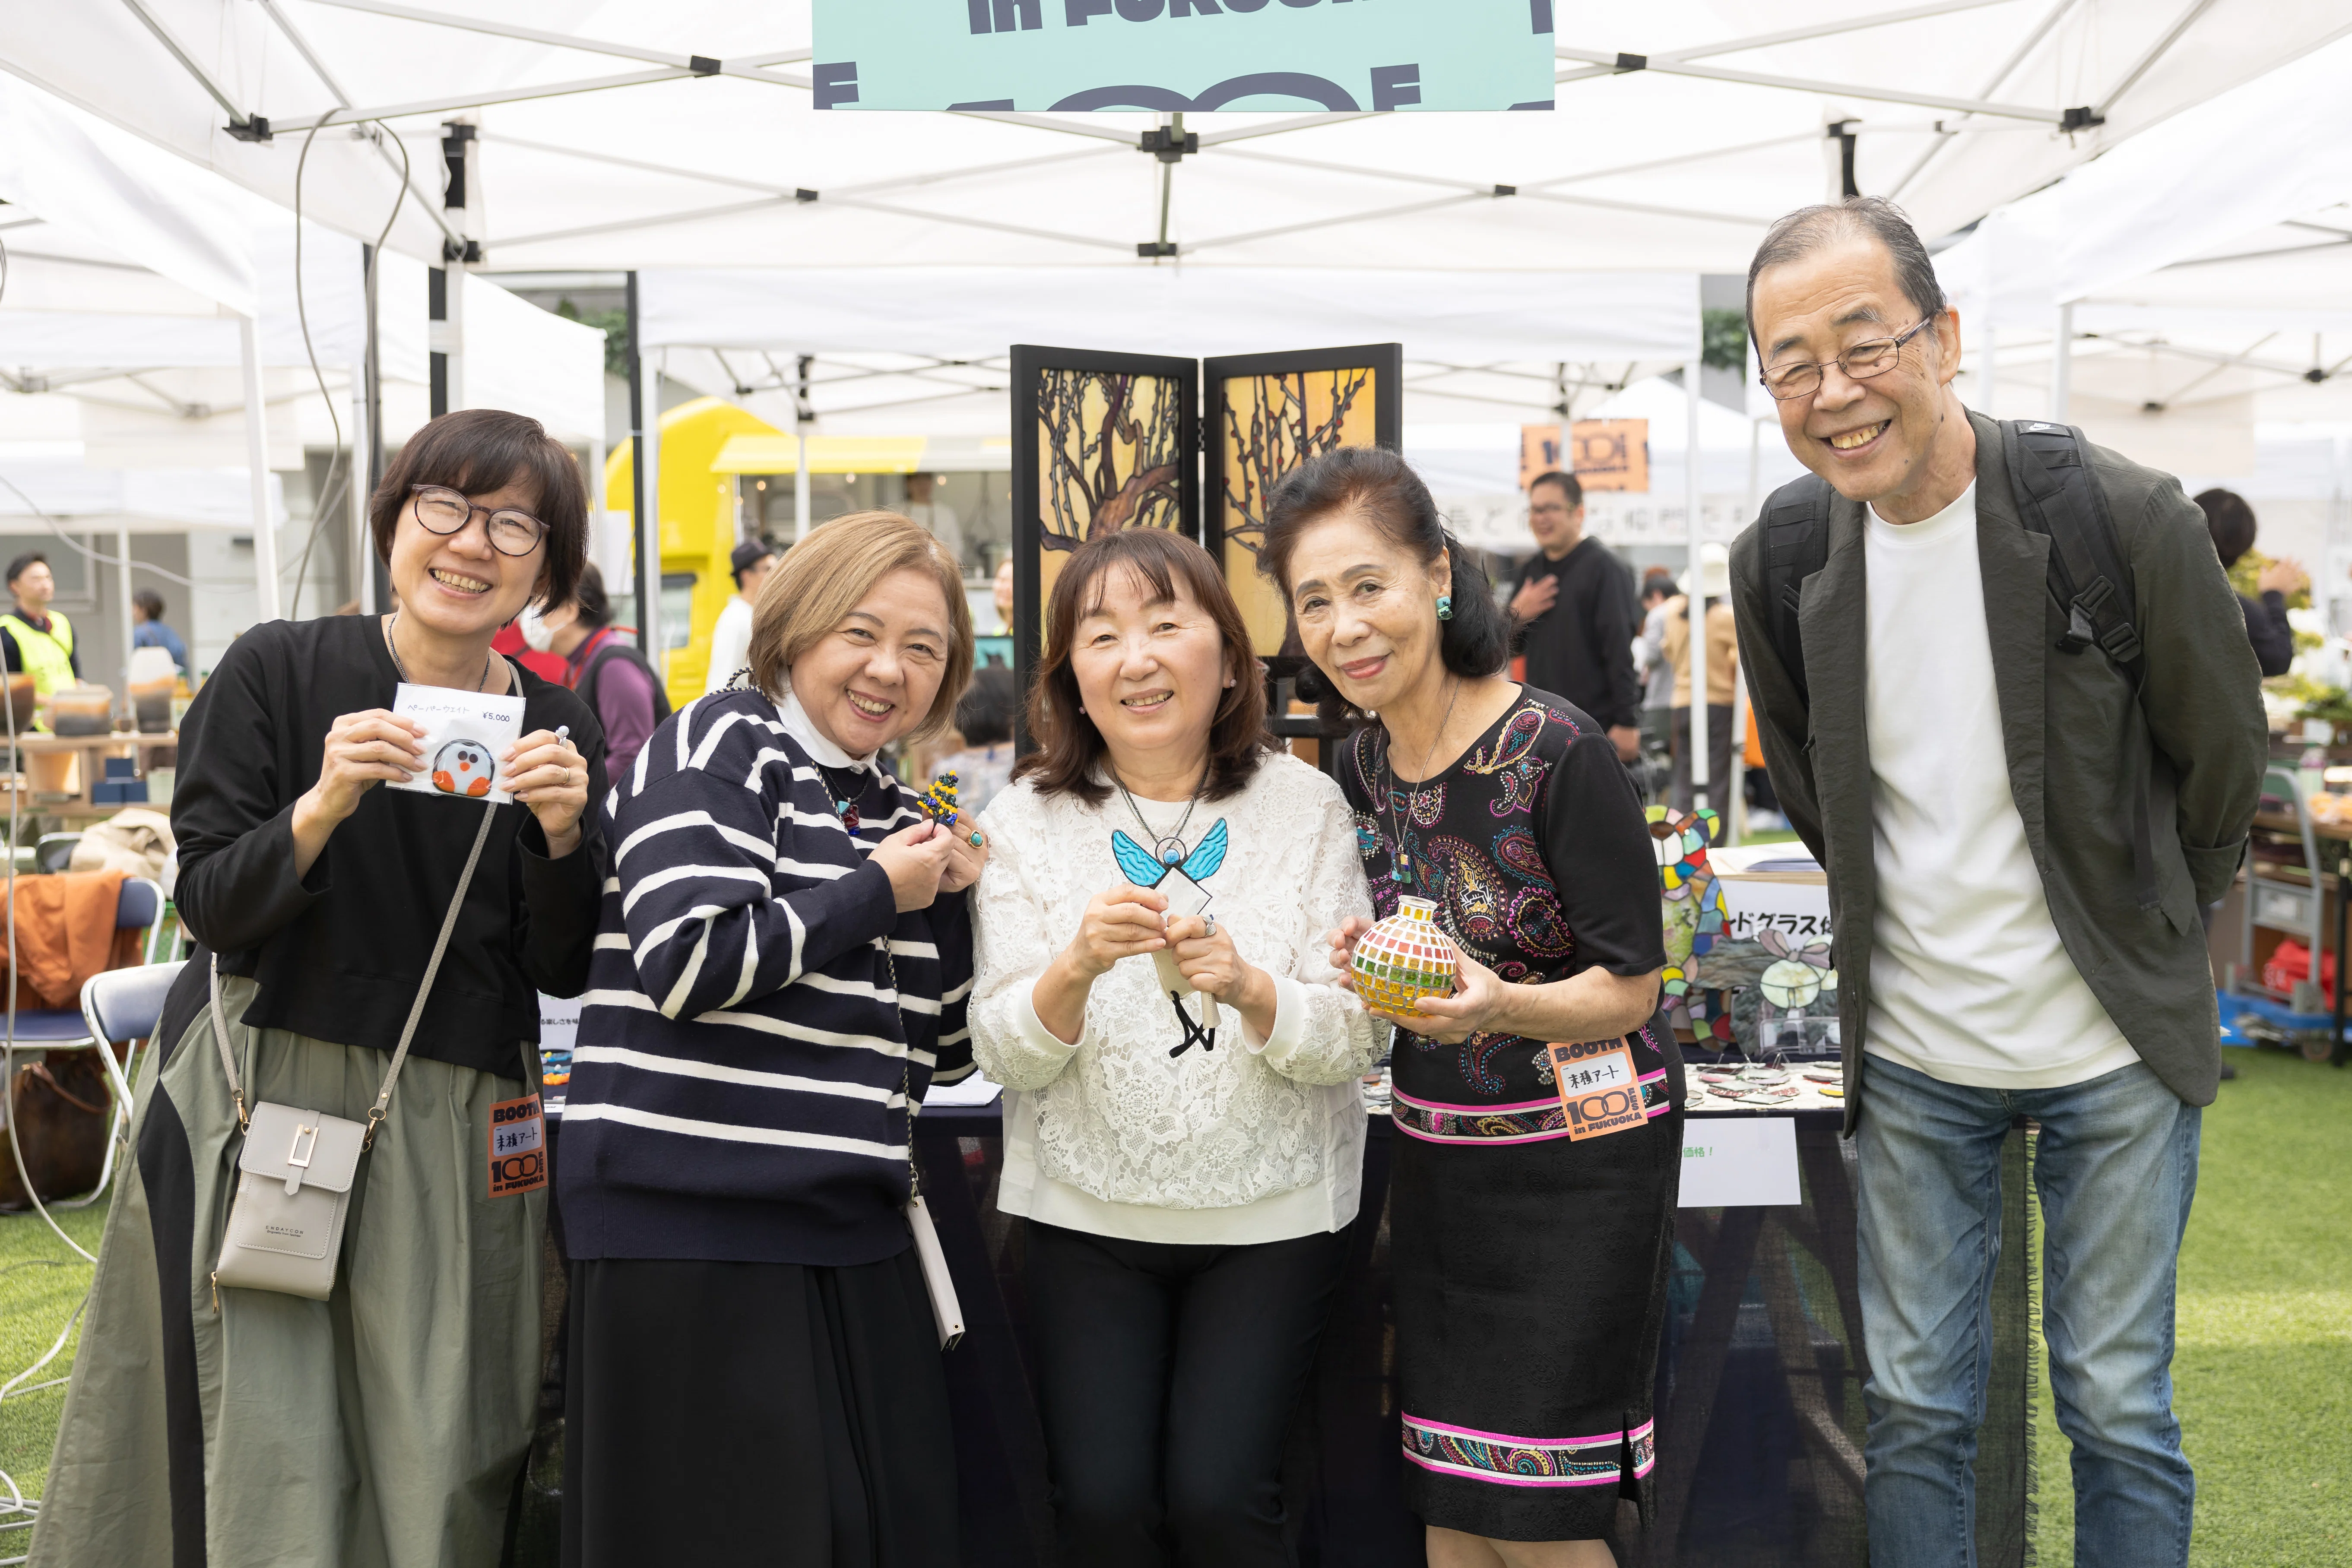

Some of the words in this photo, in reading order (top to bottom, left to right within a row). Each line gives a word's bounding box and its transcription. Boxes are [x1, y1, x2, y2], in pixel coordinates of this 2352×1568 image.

[1554, 1037, 1623, 1063] BOOTH
[1566, 1091, 1630, 1125] 100
[1627, 1087, 1639, 1111] FES
[493, 1100, 540, 1123] BOOTH
[1574, 1126, 1586, 1135] in
[1588, 1112, 1642, 1131] FUKUOKA
[491, 1153, 539, 1183] 100
[493, 1183, 503, 1192] in
[505, 1174, 545, 1191] FUKUOKA
[266, 1225, 304, 1234] ENDAYCON
